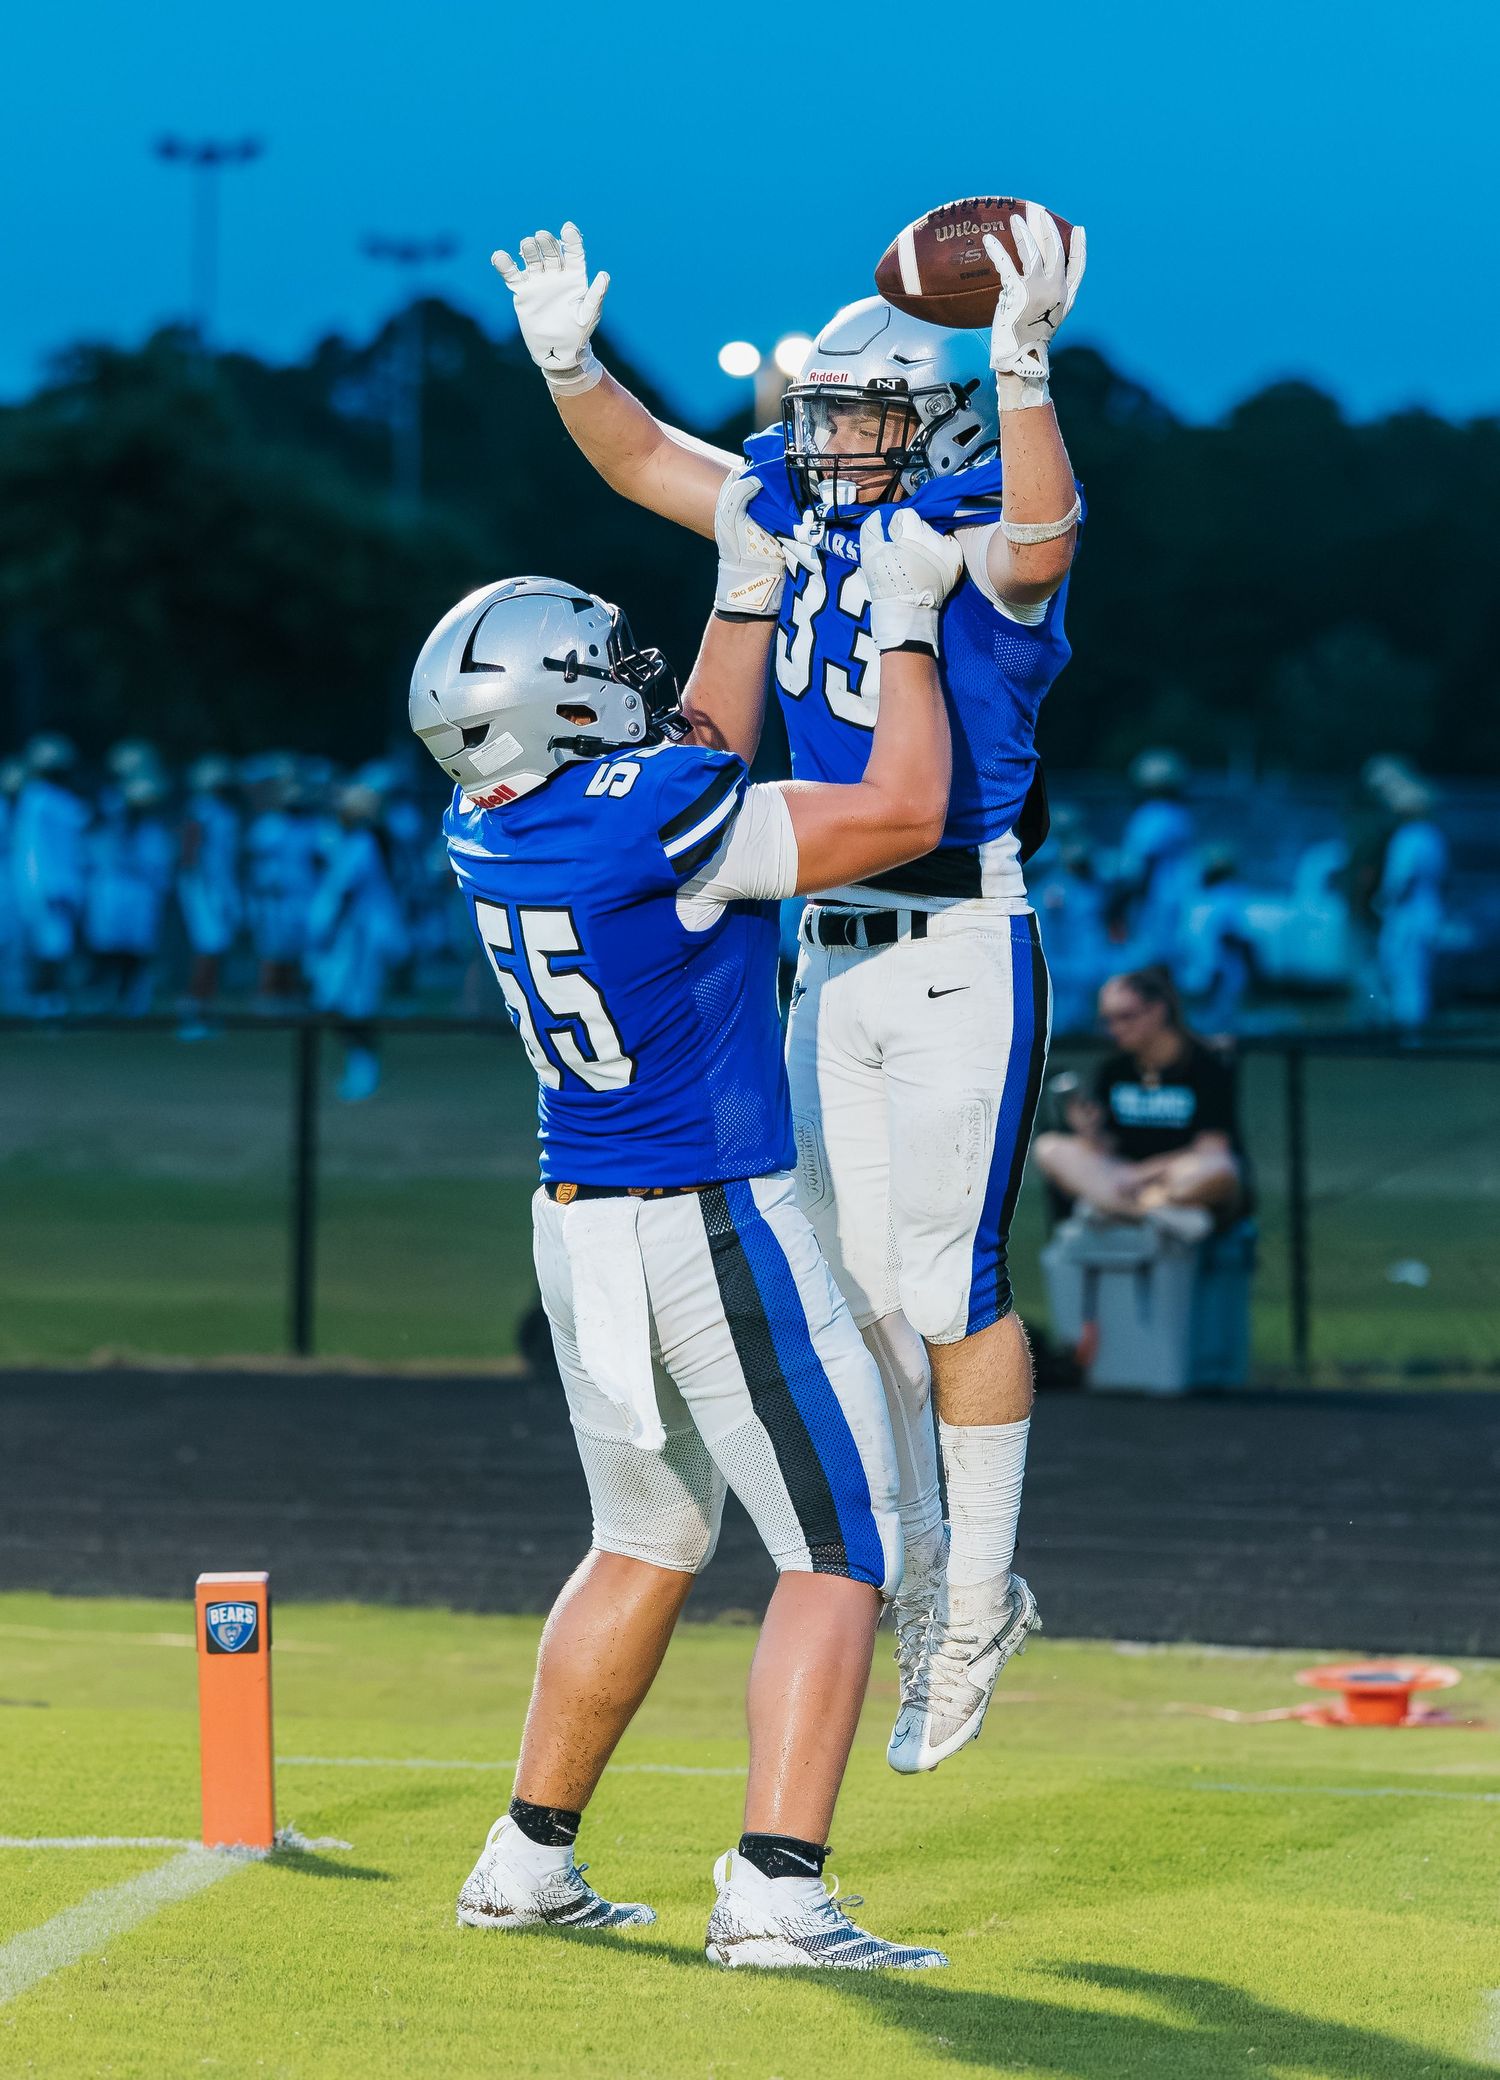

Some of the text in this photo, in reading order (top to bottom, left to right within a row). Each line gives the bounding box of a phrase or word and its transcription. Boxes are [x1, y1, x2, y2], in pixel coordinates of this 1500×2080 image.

[934, 220, 1006, 242] Wilson
[809, 372, 849, 383] Riddell
[776, 536, 882, 732] 33
[474, 895, 638, 1092] 55
[210, 1606, 254, 1625] BEARS
